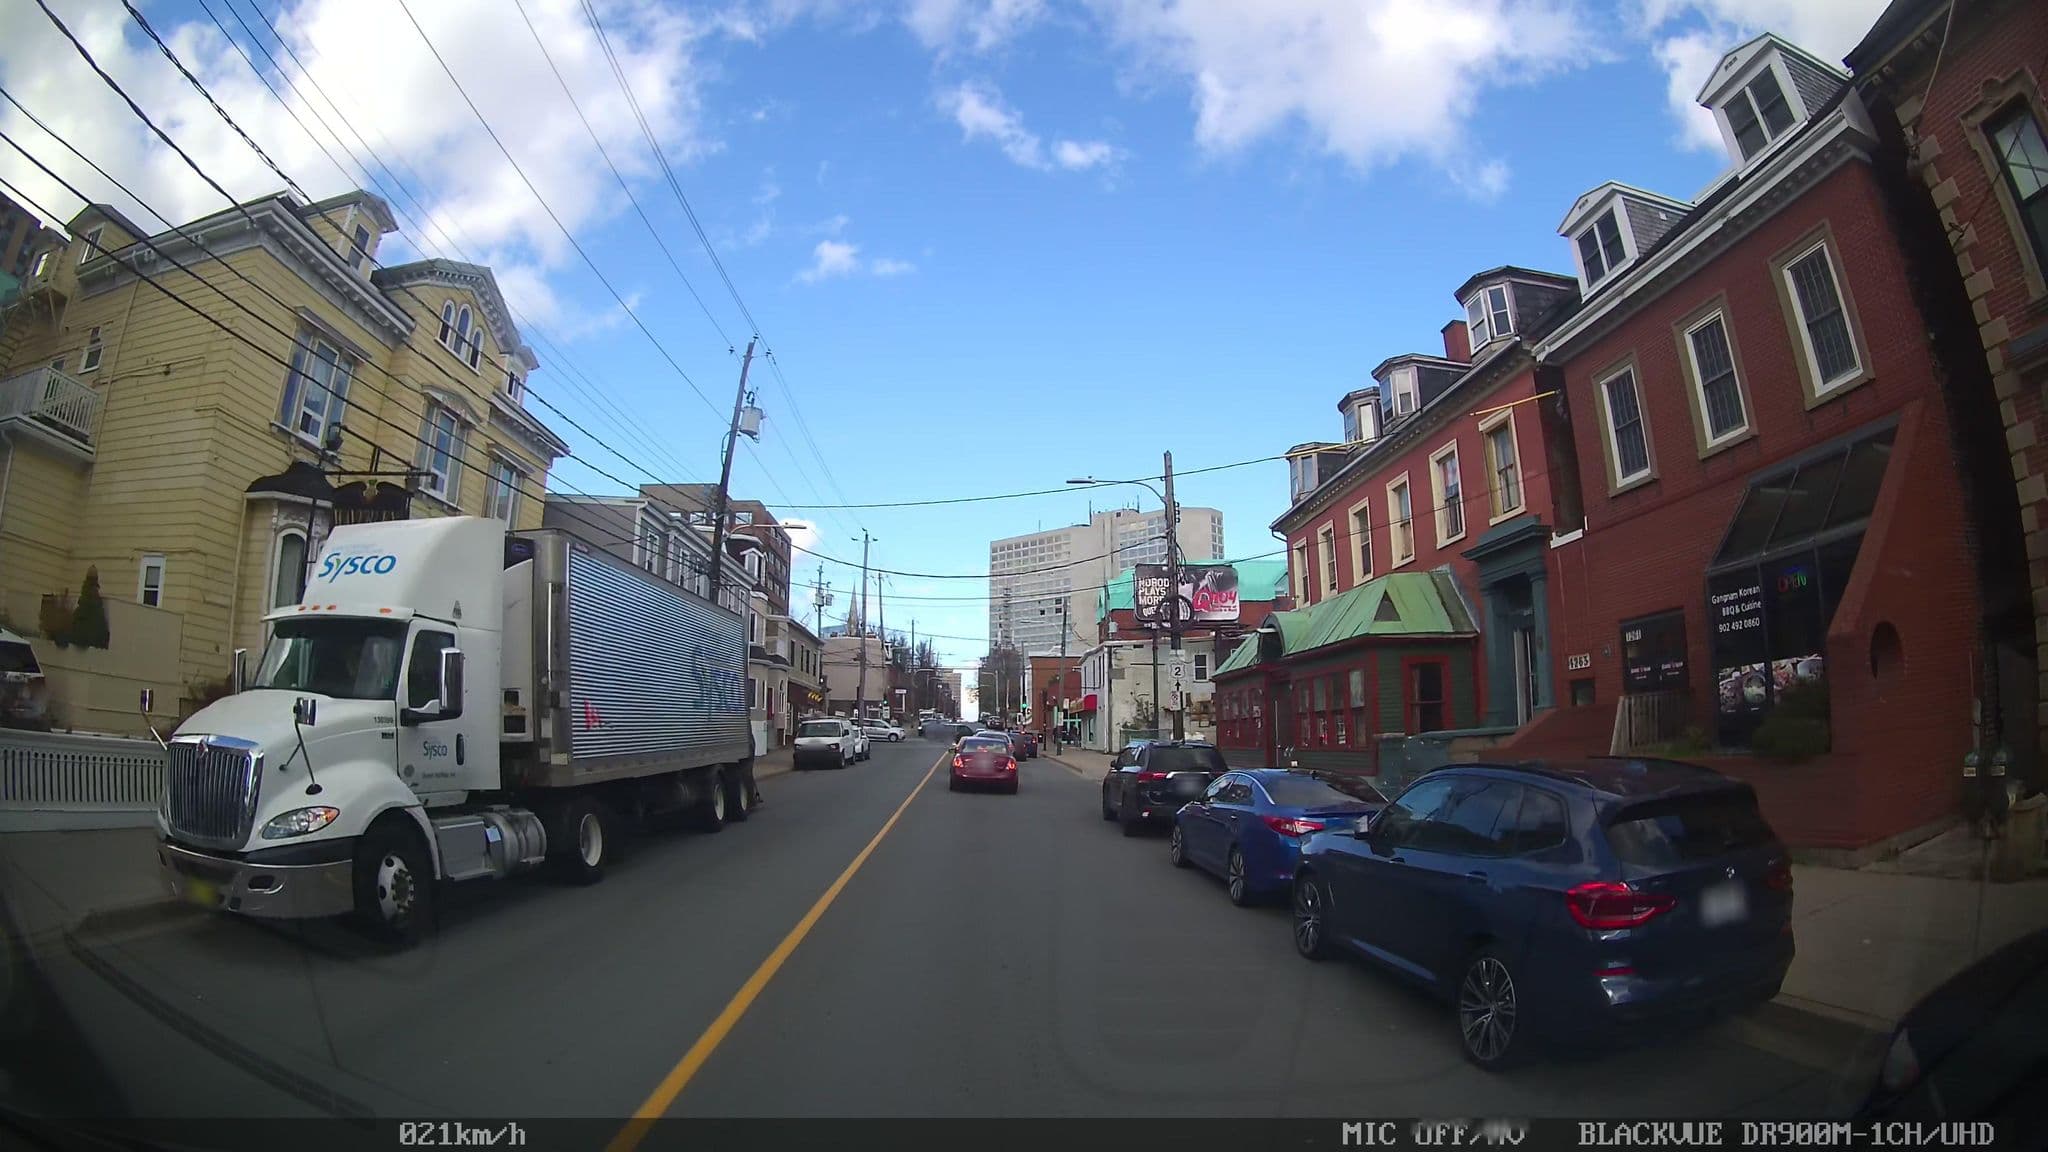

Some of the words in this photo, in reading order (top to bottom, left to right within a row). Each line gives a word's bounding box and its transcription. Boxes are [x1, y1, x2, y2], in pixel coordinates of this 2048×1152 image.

[318, 552, 397, 583] Sysco
[1138, 577, 1170, 588] NOBOD
[1138, 587, 1167, 596] PLAYS
[1711, 591, 1739, 605] Gangnam
[1739, 585, 1761, 598] Korean
[1741, 600, 1762, 613] Cuisine
[1718, 622, 1731, 633] 902
[1731, 620, 1743, 631] 492
[1174, 666, 1182, 677] 2
[423, 741, 448, 760] Sysco
